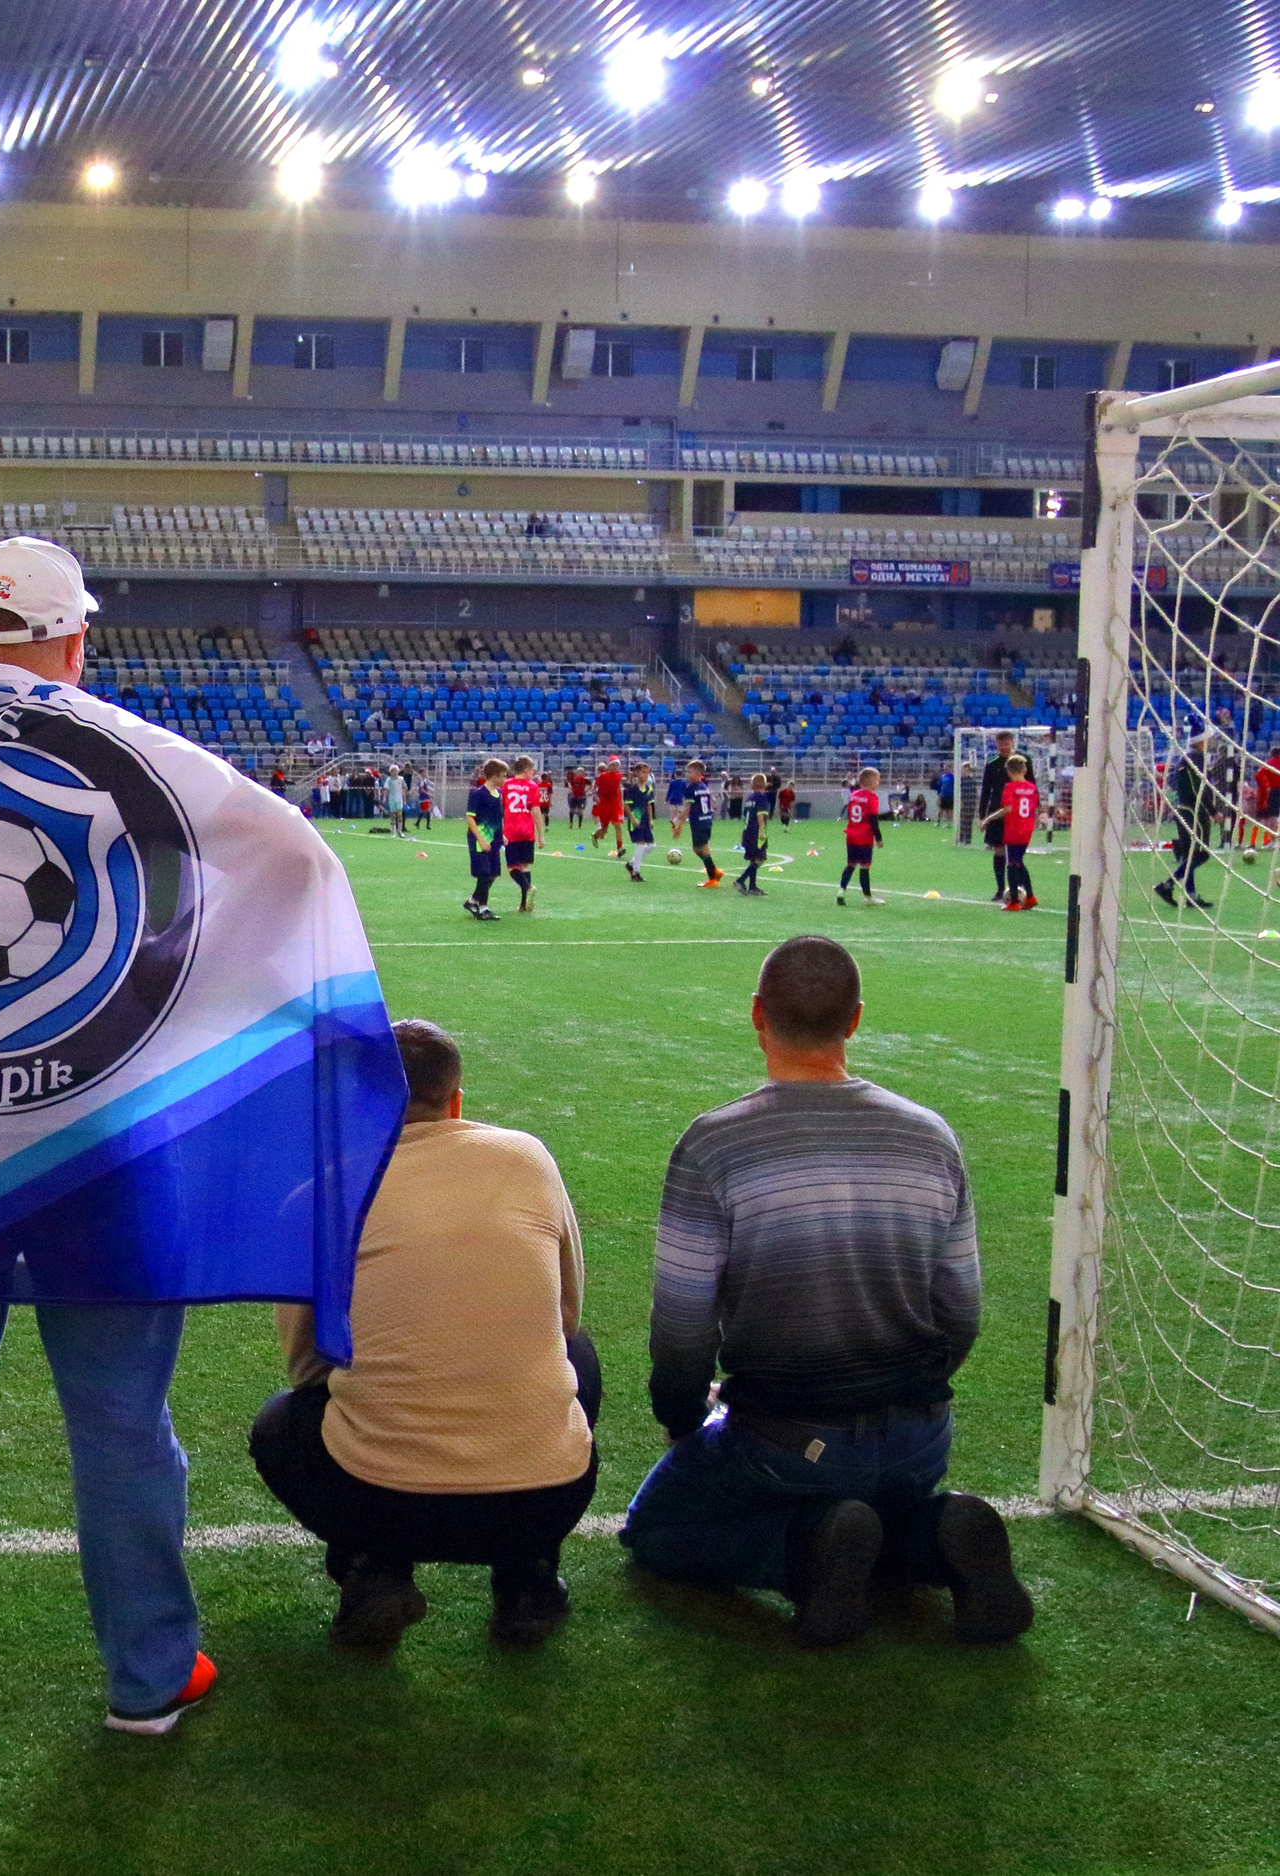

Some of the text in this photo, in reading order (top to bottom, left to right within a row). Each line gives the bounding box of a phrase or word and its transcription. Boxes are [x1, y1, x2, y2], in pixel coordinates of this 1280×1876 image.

[870, 562, 943, 572] ОДНА КОМАНДА
[870, 571, 902, 583] ОДНА
[459, 599, 472, 617] 2
[679, 604, 692, 623] 3
[507, 792, 530, 813] 21
[1018, 797, 1029, 818] 8
[850, 804, 862, 823] 9
